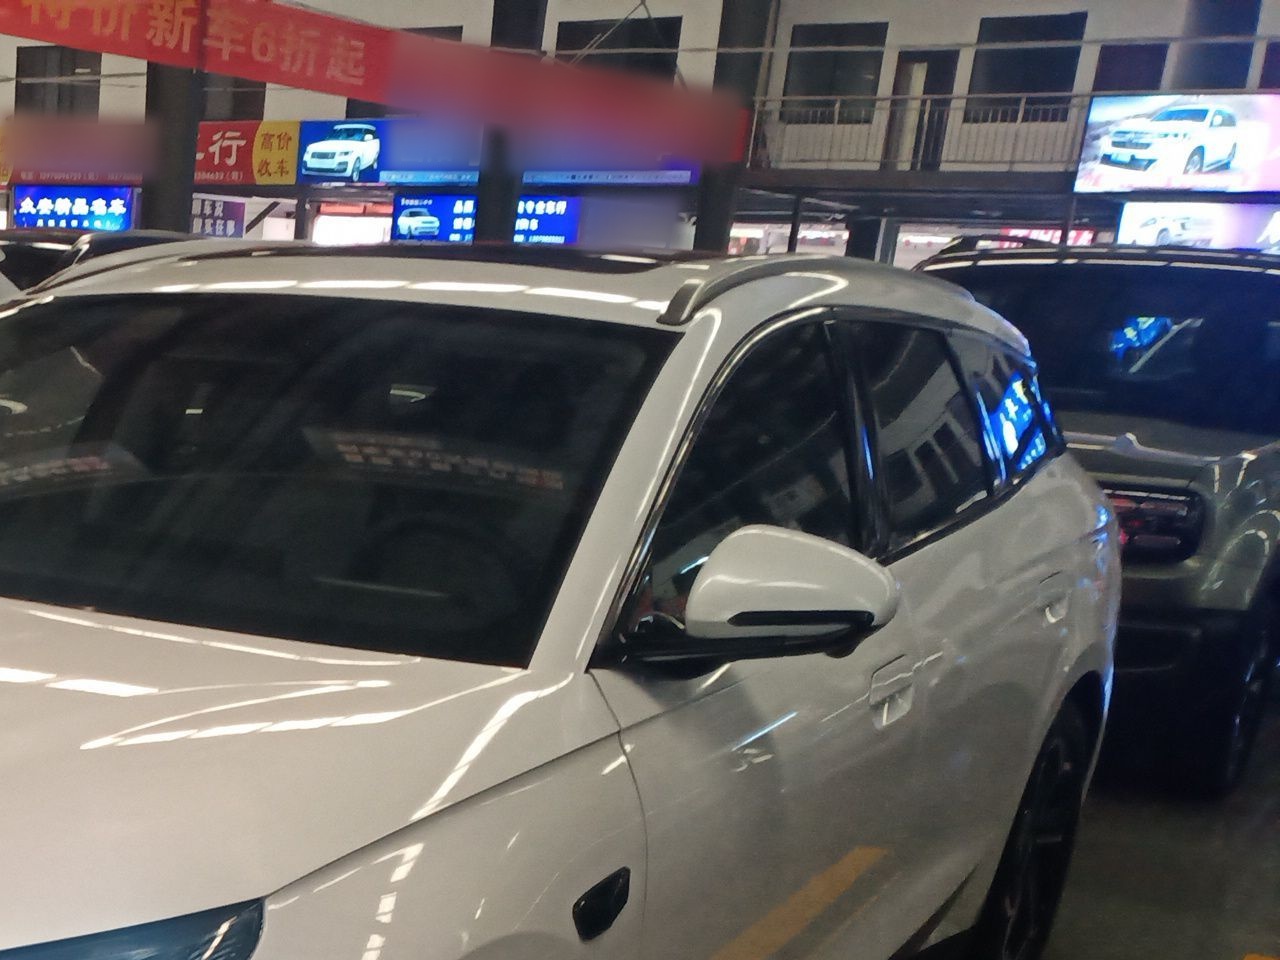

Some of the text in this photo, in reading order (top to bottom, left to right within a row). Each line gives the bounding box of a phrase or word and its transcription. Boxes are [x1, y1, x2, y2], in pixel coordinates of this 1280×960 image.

[196, 131, 247, 167] 行
[261, 131, 292, 152] 高价
[257, 158, 290, 177] 收车
